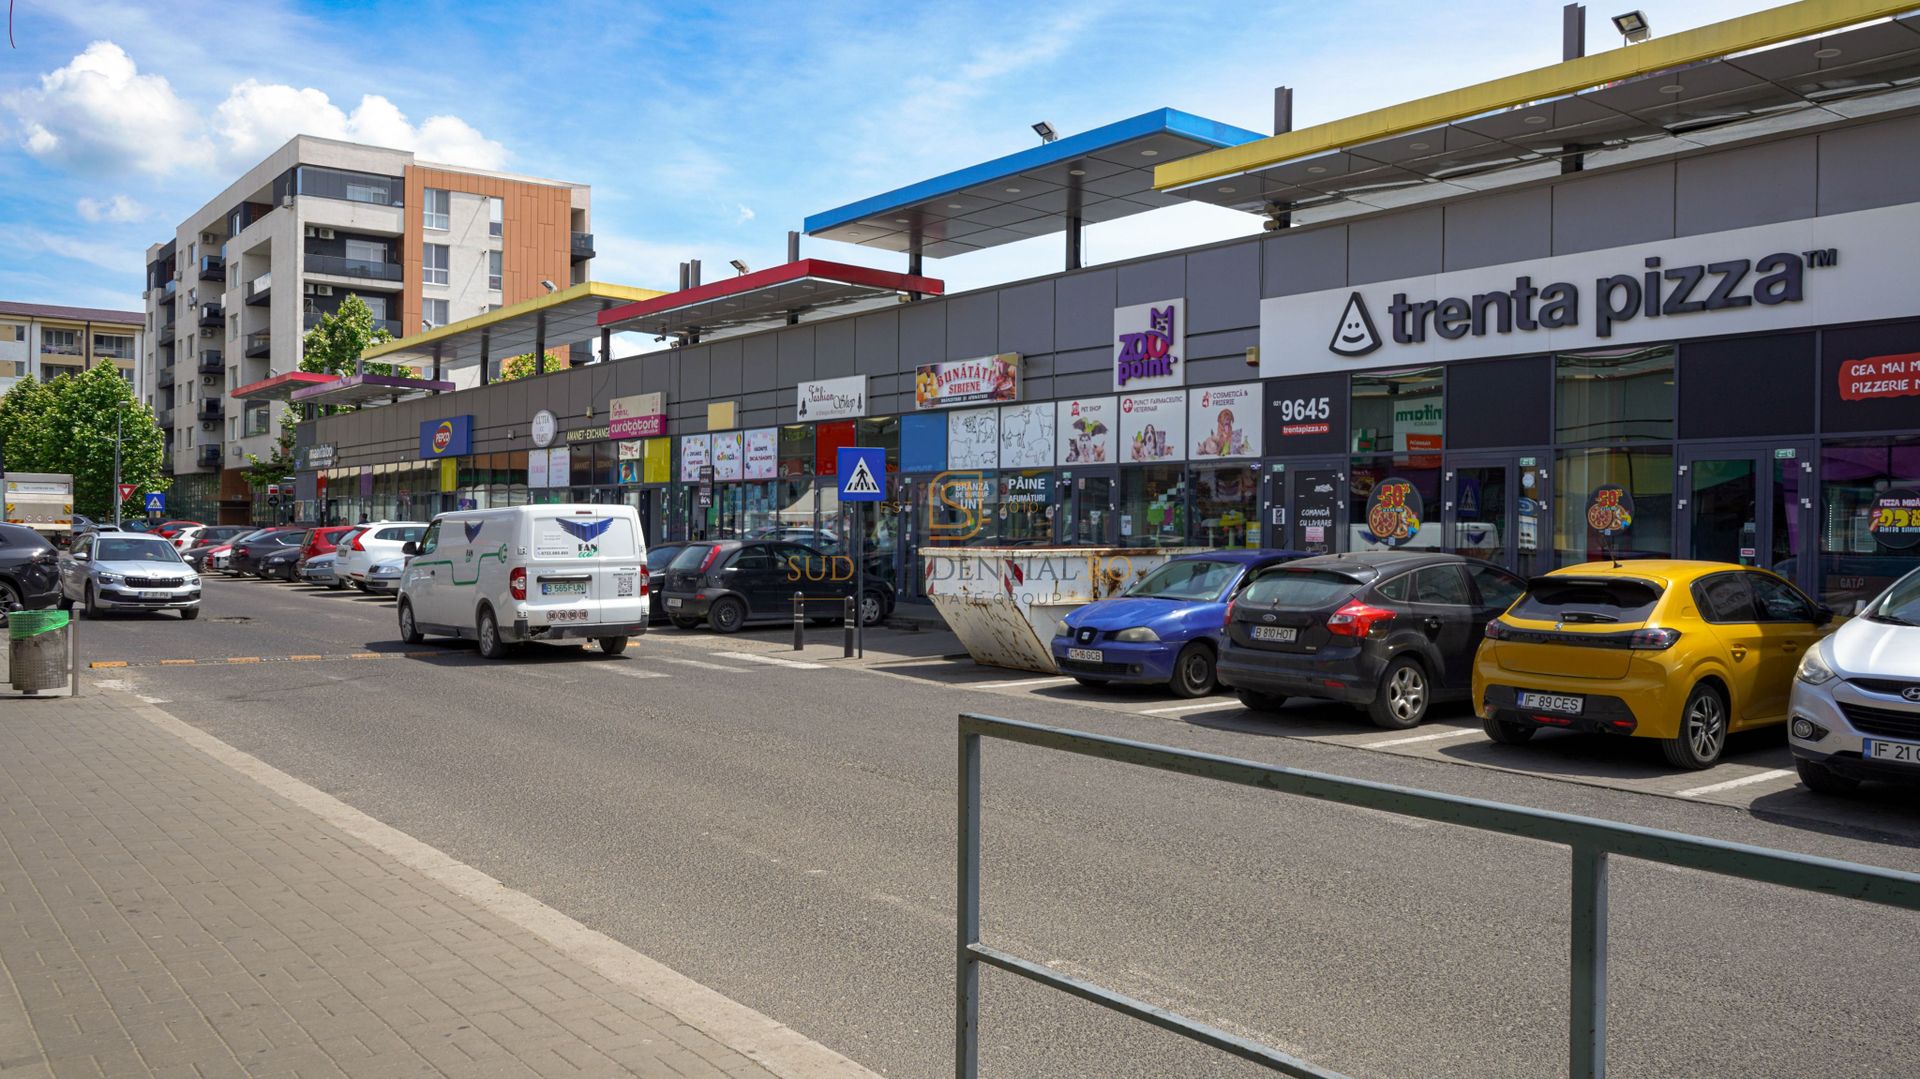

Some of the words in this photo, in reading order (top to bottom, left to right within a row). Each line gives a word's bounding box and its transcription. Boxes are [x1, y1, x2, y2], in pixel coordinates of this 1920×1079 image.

[1388, 276, 1579, 344] trenta
[1596, 252, 1803, 338] pizza
[1118, 353, 1172, 386] point
[1851, 364, 1876, 376] CEA
[1881, 361, 1905, 374] MAI
[948, 381, 981, 394] SIBIENE
[1852, 379, 1909, 393] PIZZERIE
[1150, 396, 1183, 404] FARMACEUTIC
[1134, 405, 1158, 413] VETERINAR
[1281, 397, 1330, 421] 9645
[1283, 425, 1328, 434] trentapizza.ro
[1008, 476, 1046, 490] PÂINE
[1008, 493, 1046, 502] AFUMĂTURI
[960, 498, 984, 510] UNT
[1301, 507, 1330, 516] COMANDĂ
[578, 544, 599, 552] FAN
[554, 584, 568, 592] 565
[1256, 628, 1261, 637] B
[1263, 628, 1275, 638] 810
[1277, 629, 1294, 639] HOT
[1525, 694, 1535, 706] IF
[1538, 697, 1551, 708] 89
[1553, 698, 1578, 710] CES
[1875, 742, 1888, 756] IF
[1895, 745, 1910, 760] 21
